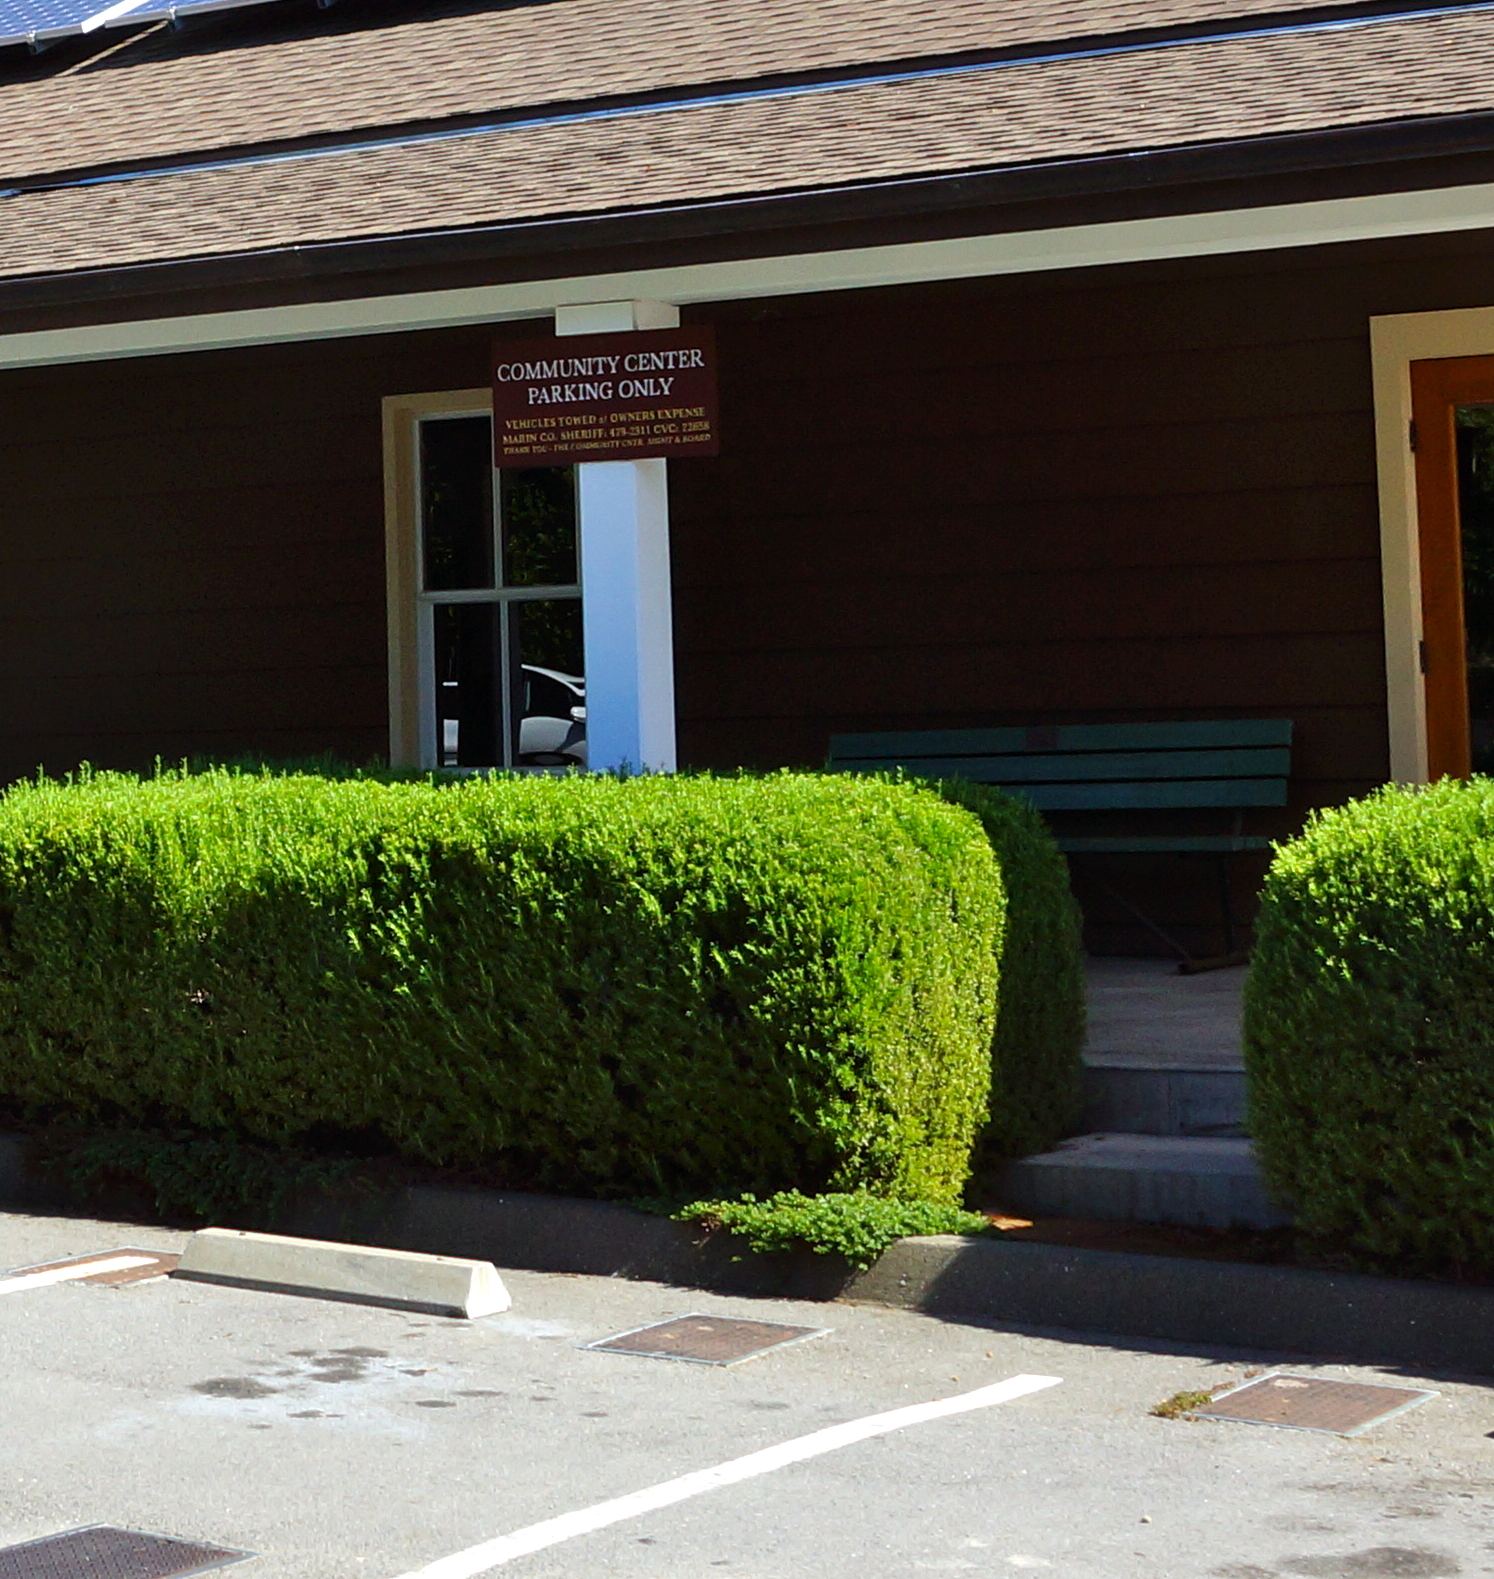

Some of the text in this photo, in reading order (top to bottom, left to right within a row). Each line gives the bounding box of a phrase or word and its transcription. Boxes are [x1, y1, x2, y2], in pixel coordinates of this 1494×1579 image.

[497, 349, 705, 382] COMMUNITY CENTER
[528, 377, 675, 405] PARKING ONLY
[505, 415, 557, 431] VEHICLES
[559, 413, 598, 428] TOWED
[609, 408, 656, 424] OWNERS
[657, 406, 706, 421] EXPENSE
[502, 433, 538, 446] MARIN
